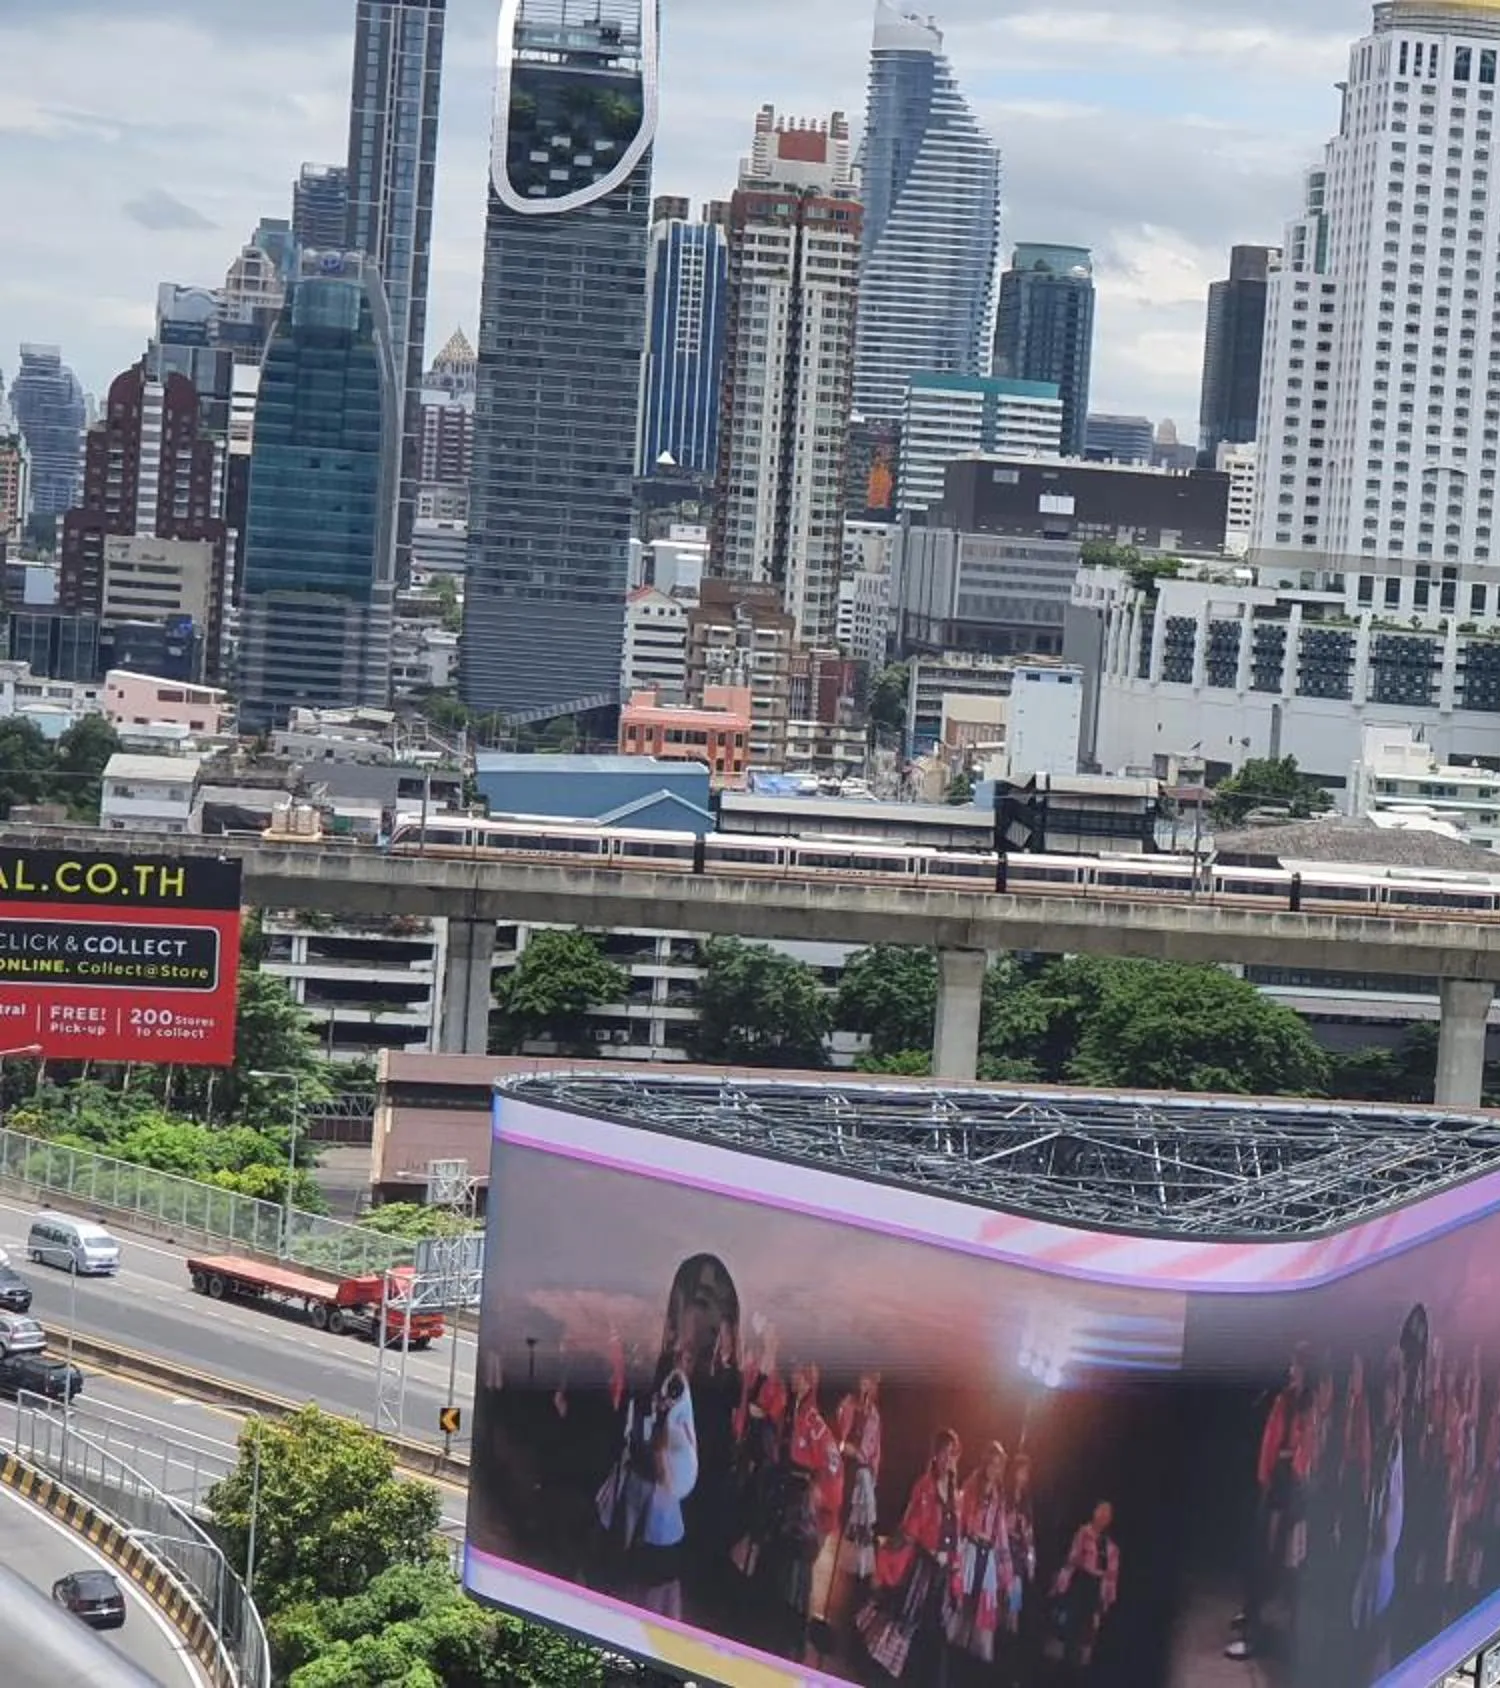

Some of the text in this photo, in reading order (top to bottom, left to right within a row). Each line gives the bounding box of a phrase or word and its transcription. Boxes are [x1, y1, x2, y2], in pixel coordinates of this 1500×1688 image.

[65, 935, 79, 951] &
[83, 936, 188, 957] COLLECT
[77, 961, 209, 979] Collect@Store
[50, 1005, 107, 1021] FREE!
[130, 1008, 173, 1025] 200
[50, 1021, 107, 1036] Pick-up
